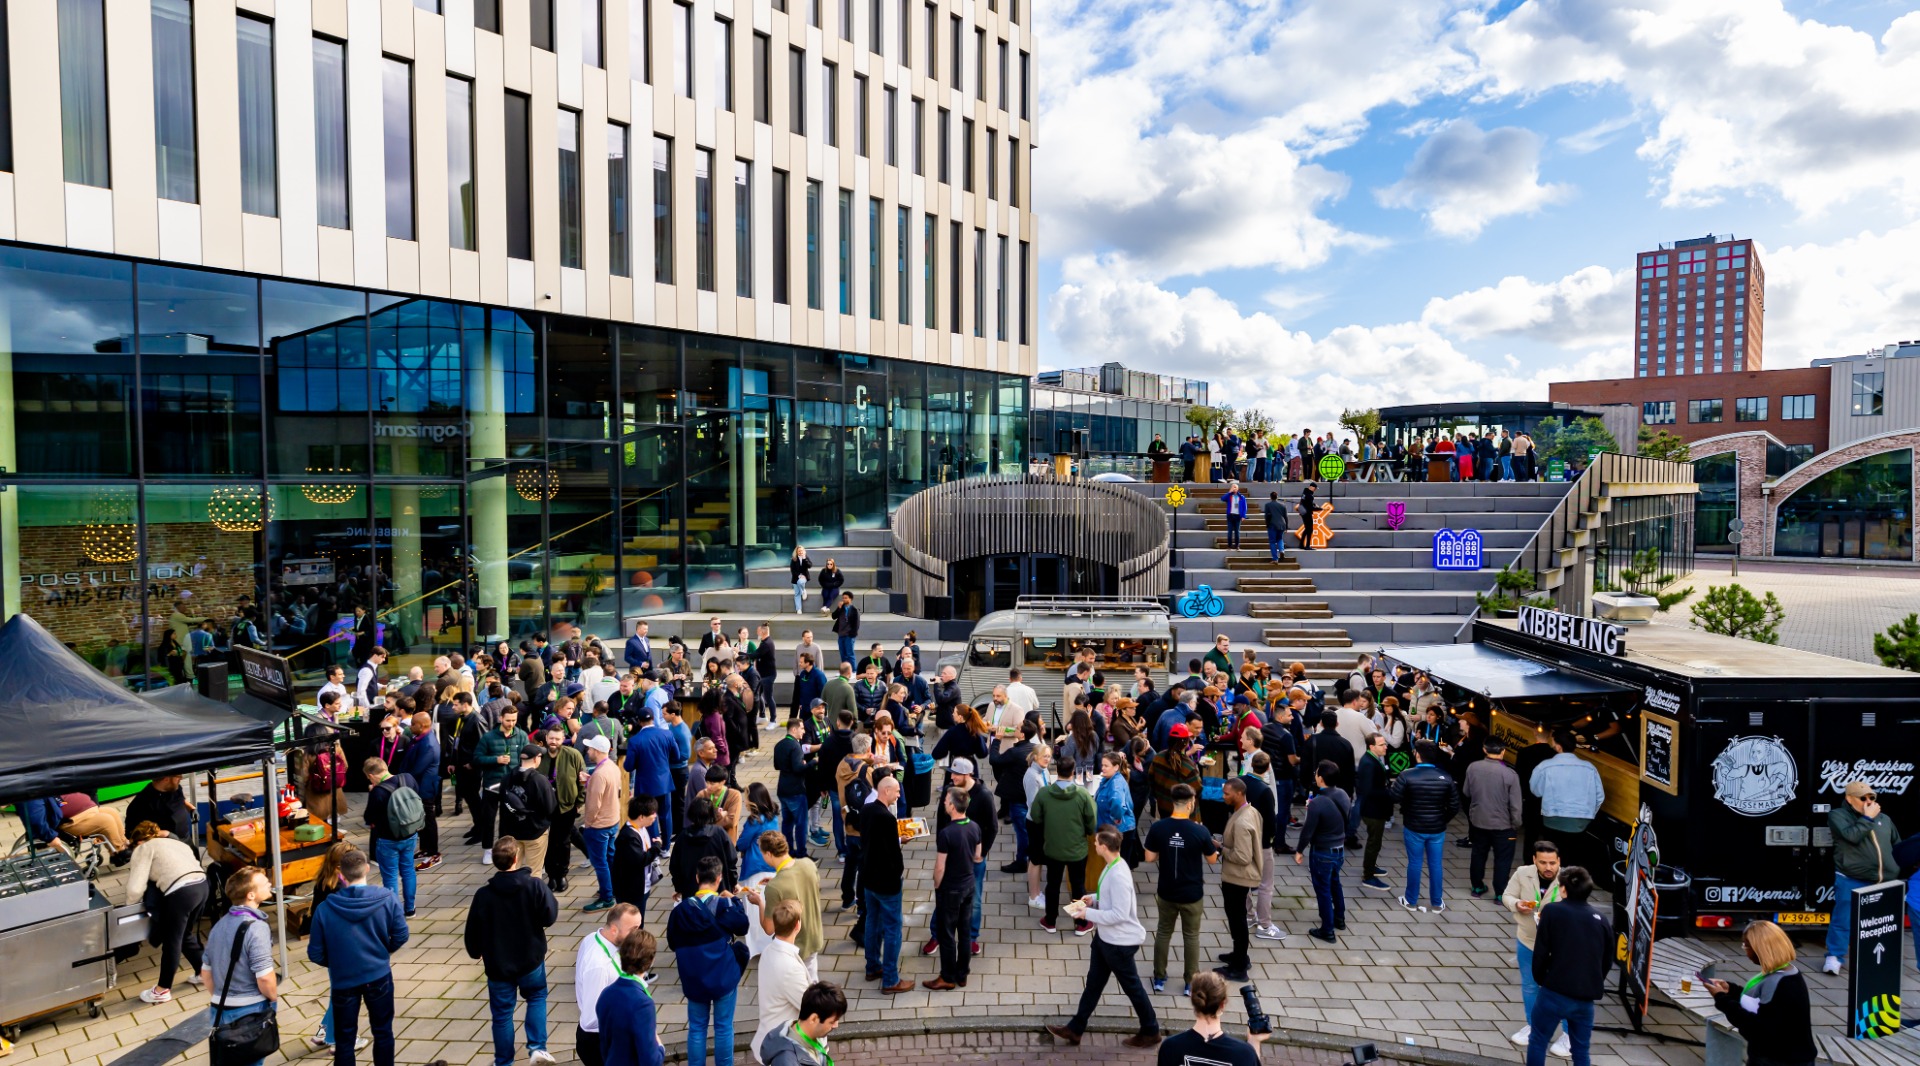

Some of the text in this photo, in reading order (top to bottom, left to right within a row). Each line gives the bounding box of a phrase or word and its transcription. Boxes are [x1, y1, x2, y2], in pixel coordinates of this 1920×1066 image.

[857, 385, 867, 410] C
[20, 566, 195, 587] POSTILLION
[1519, 606, 1618, 656] KIBBELING
[1821, 759, 1915, 775] Vers Gebakken
[1818, 771, 1914, 795] Kibbeling
[1734, 800, 1776, 809] VISSEMAN
[1738, 886, 1802, 902] Visseman
[1781, 913, 1826, 922] V-396-TS
[1860, 914, 1895, 929] Welcome
[1860, 924, 1897, 939] Reception
